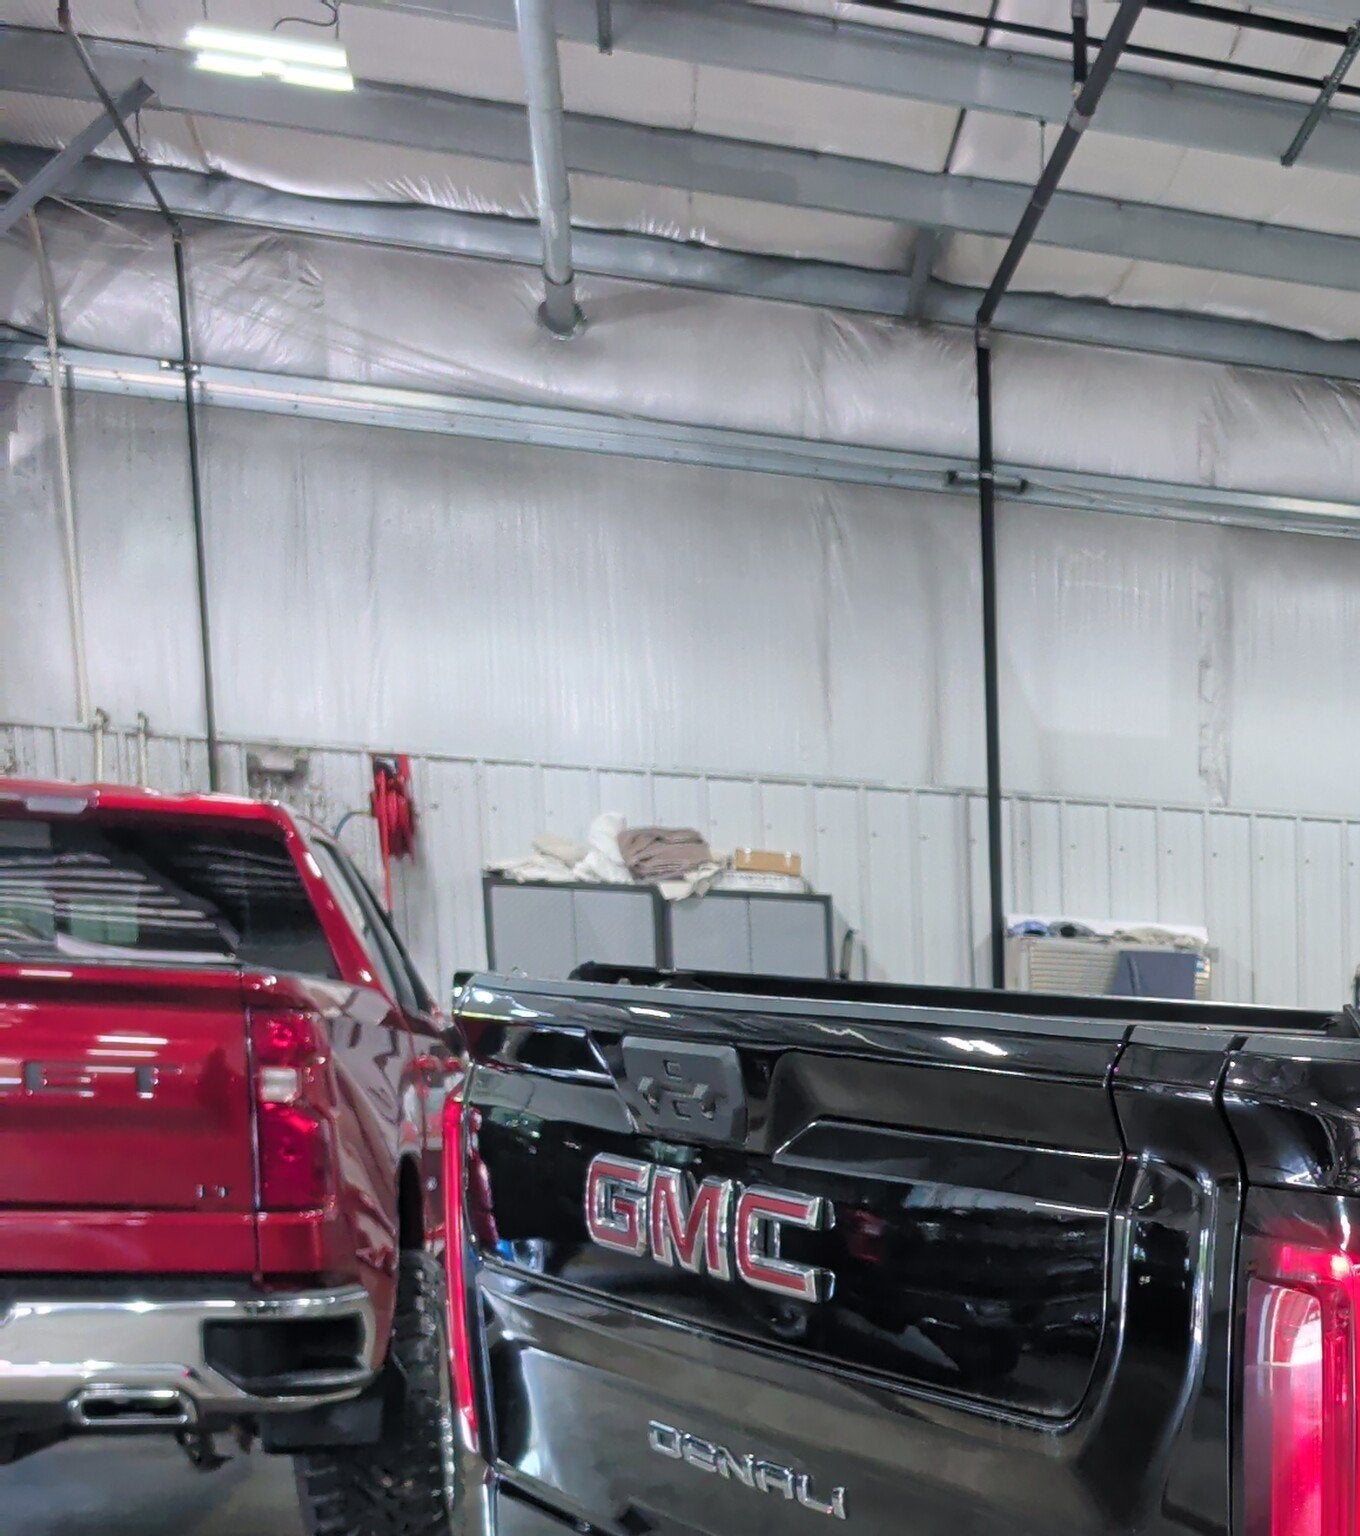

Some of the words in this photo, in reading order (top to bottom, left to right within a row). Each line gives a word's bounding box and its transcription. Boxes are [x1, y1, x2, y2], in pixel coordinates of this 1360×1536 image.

[0, 1060, 183, 1100] ET
[585, 1151, 824, 1303] GMC
[648, 1419, 848, 1520] DENALI
